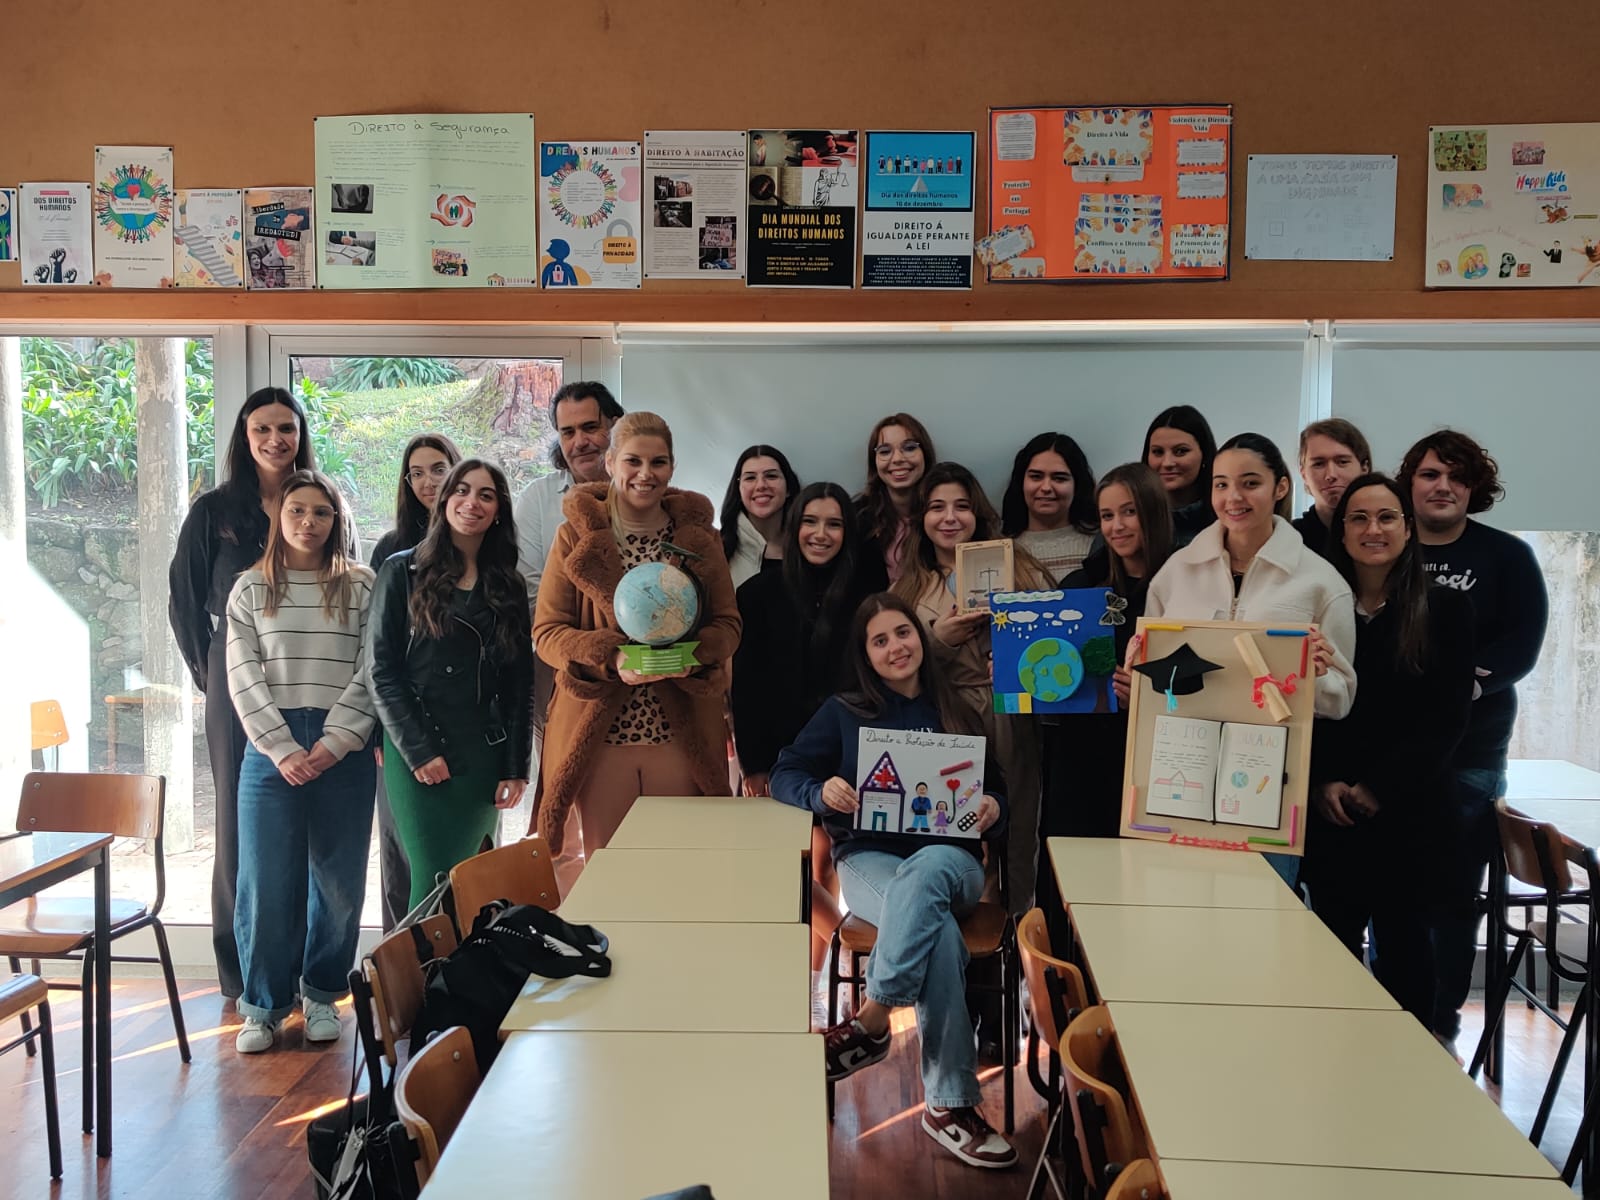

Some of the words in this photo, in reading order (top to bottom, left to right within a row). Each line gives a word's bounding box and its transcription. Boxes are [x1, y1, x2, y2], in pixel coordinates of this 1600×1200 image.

[591, 146, 636, 156] HUMANOS
[647, 148, 682, 156] DIREITO
[694, 148, 745, 158] HABITAÇÃO
[1516, 174, 1546, 190] Happy
[1546, 170, 1566, 187] Kids
[1004, 207, 1031, 215] Portugal
[762, 213, 778, 224] DIA
[781, 213, 820, 225] MUNDIAL
[824, 213, 841, 225] DOS
[894, 222, 933, 230] DIREITO
[758, 227, 799, 239] DIREITOS
[802, 228, 845, 239] HUMANOS
[867, 232, 922, 240] IGUALDADE
[926, 232, 970, 240] PERANTE
[905, 242, 913, 250] A
[916, 242, 930, 250] LEI
